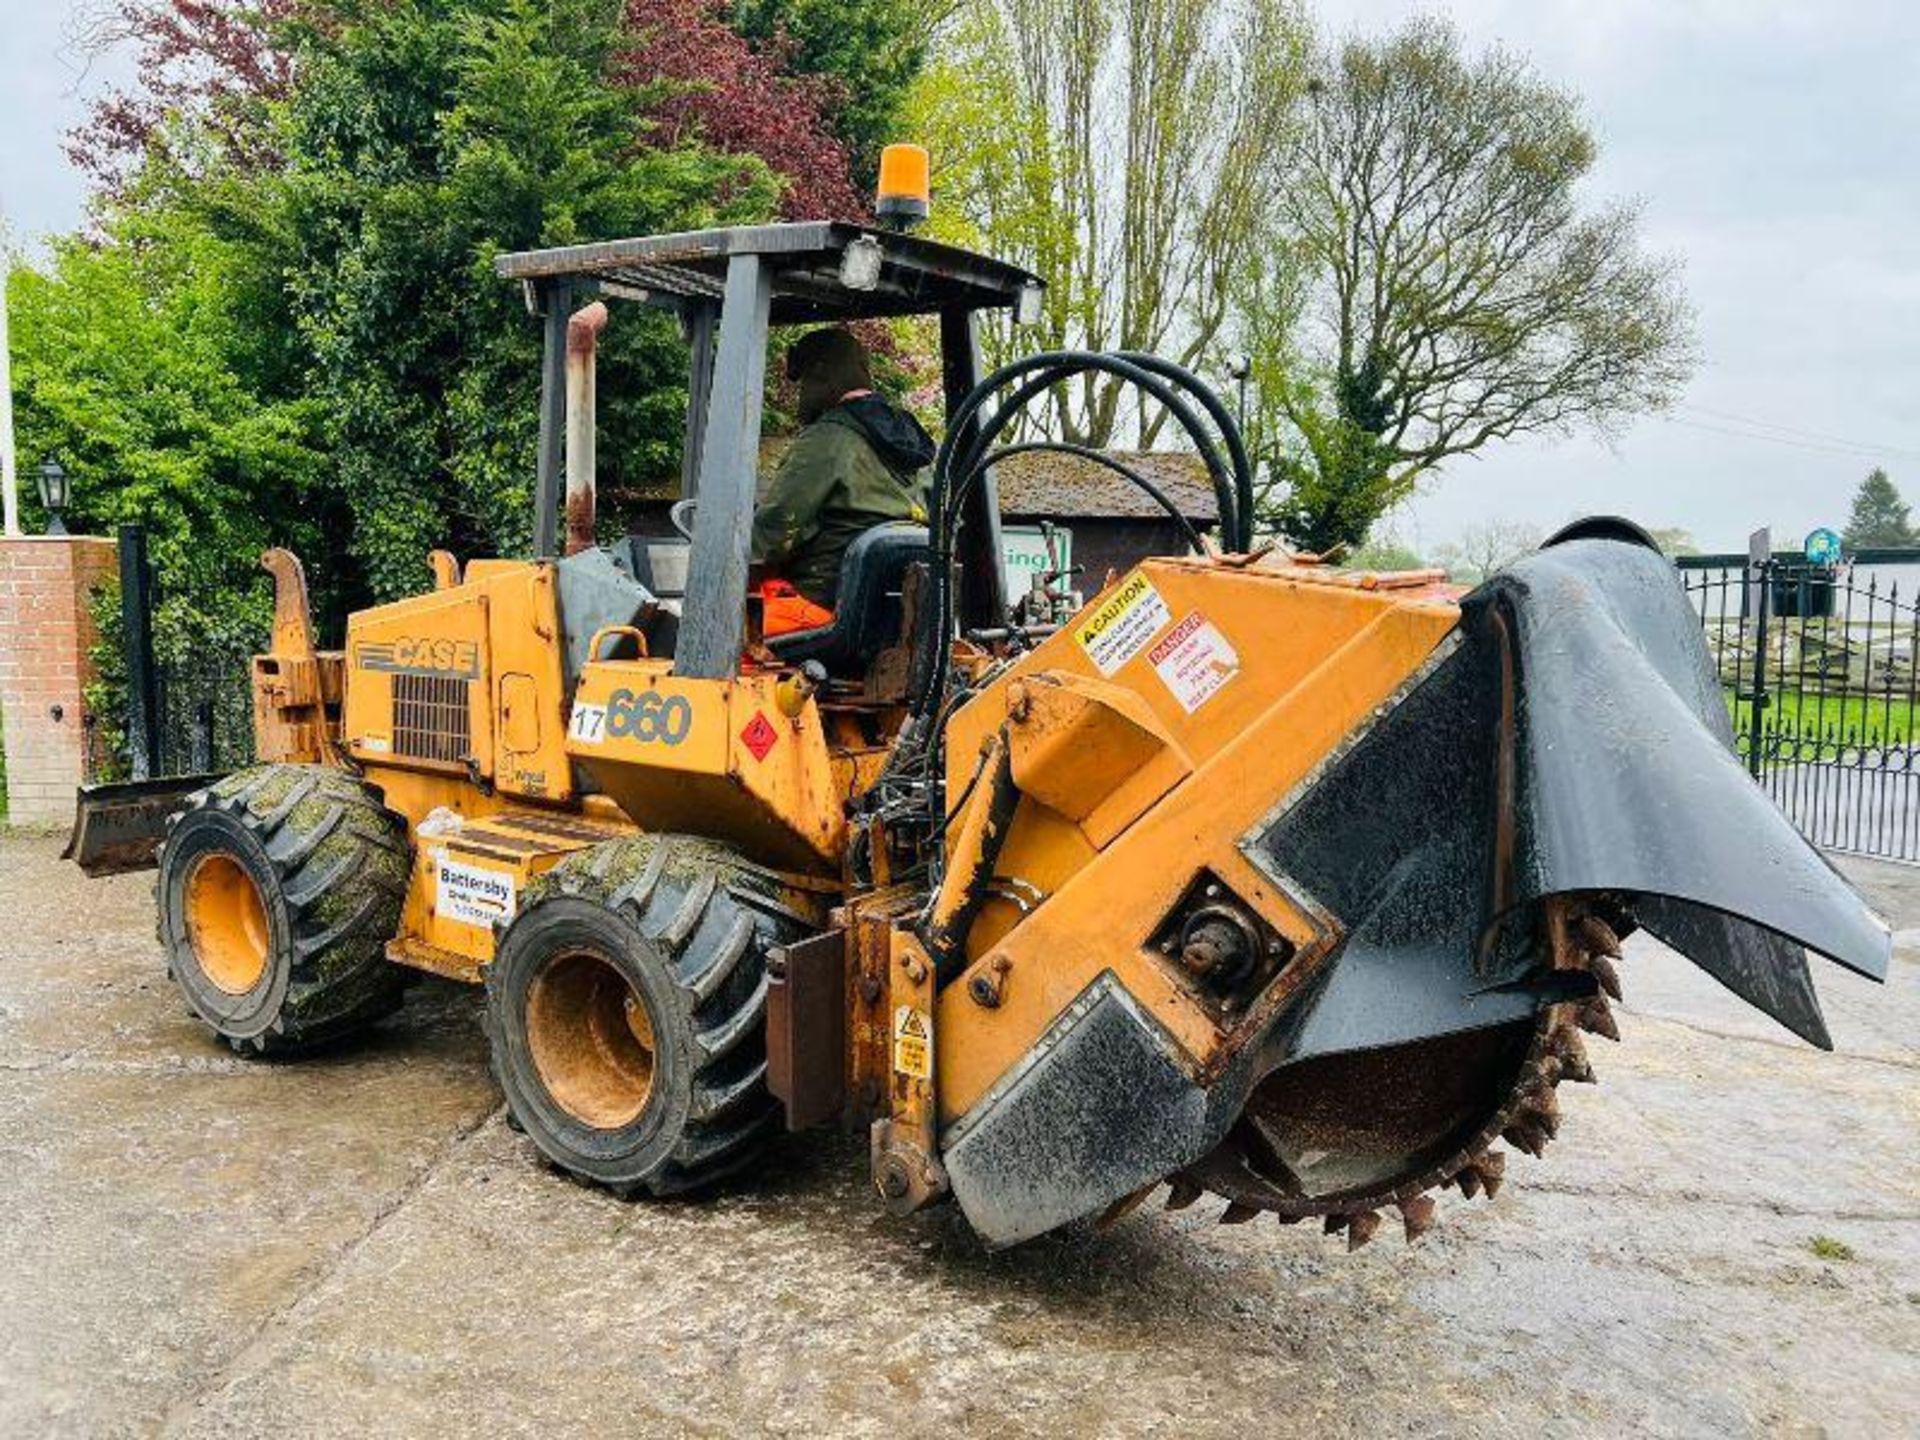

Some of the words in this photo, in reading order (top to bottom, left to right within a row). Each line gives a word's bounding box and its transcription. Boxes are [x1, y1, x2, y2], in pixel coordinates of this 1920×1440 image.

[1093, 577, 1146, 632] CAUTION
[393, 636, 476, 674] CASE
[1149, 612, 1202, 663] DANGER
[575, 707, 605, 737] 17
[605, 688, 692, 746] 660
